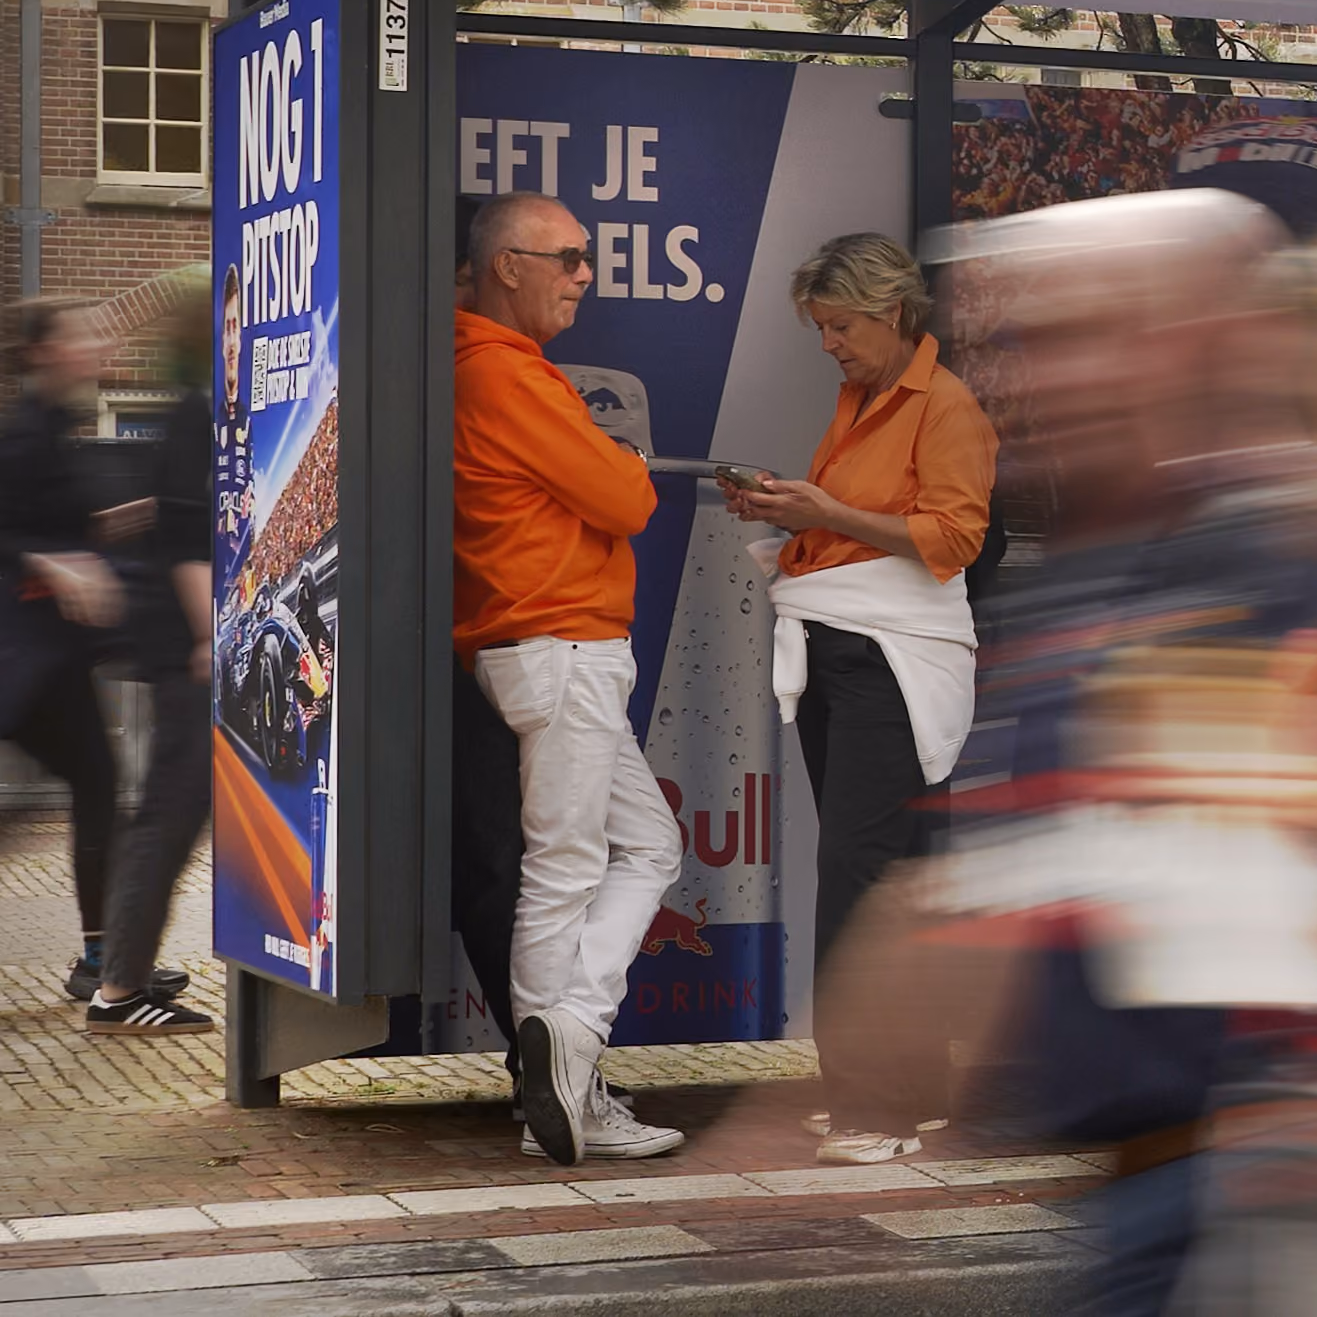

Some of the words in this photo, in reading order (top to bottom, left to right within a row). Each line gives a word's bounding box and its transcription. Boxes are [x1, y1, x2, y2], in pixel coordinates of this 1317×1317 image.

[239, 29, 303, 210] NOG
[310, 18, 323, 183] 1
[460, 117, 570, 197] EFT
[592, 125, 659, 202] JE
[242, 200, 319, 328] PITSTOP
[583, 222, 725, 303] ELS.
[637, 979, 758, 1016] DRINK
